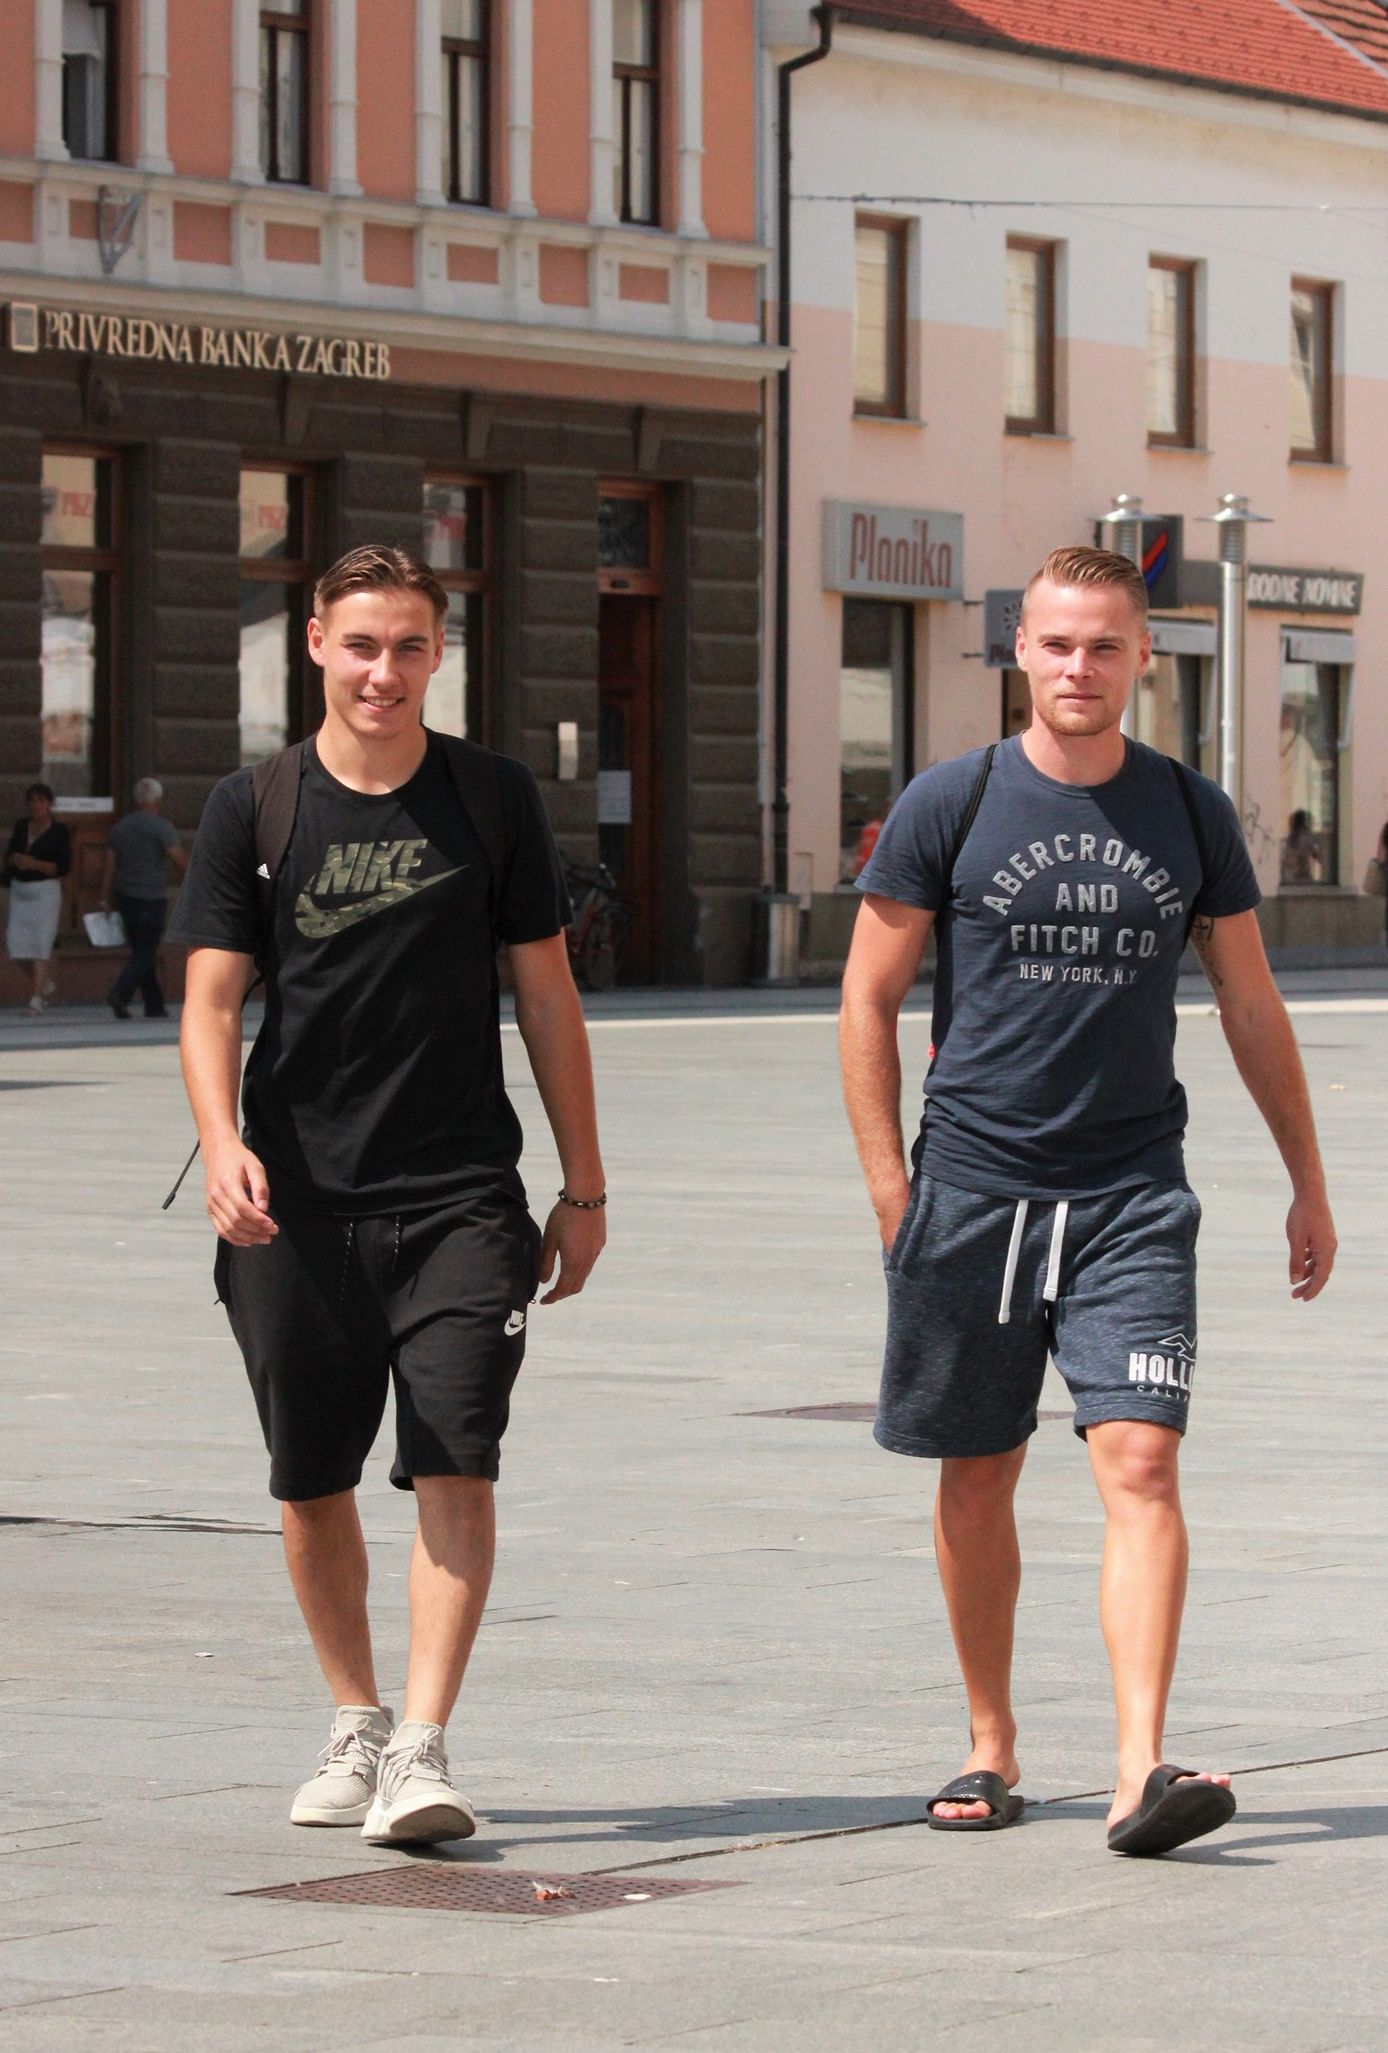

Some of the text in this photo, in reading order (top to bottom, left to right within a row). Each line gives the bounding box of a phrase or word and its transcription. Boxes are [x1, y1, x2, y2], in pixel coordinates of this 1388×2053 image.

[44, 310, 390, 379] PRIVREDNA BANKA ZAGREB
[850, 512, 953, 588] Planika
[1247, 572, 1299, 603] RODNE
[314, 838, 428, 895] NIKE
[982, 833, 1184, 920] ABERCROMBIE
[1055, 882, 1119, 914] AND
[1010, 925, 1100, 955] FITCH
[1020, 963, 1054, 981] NEW
[1128, 1352, 1195, 1393] HOLLI
